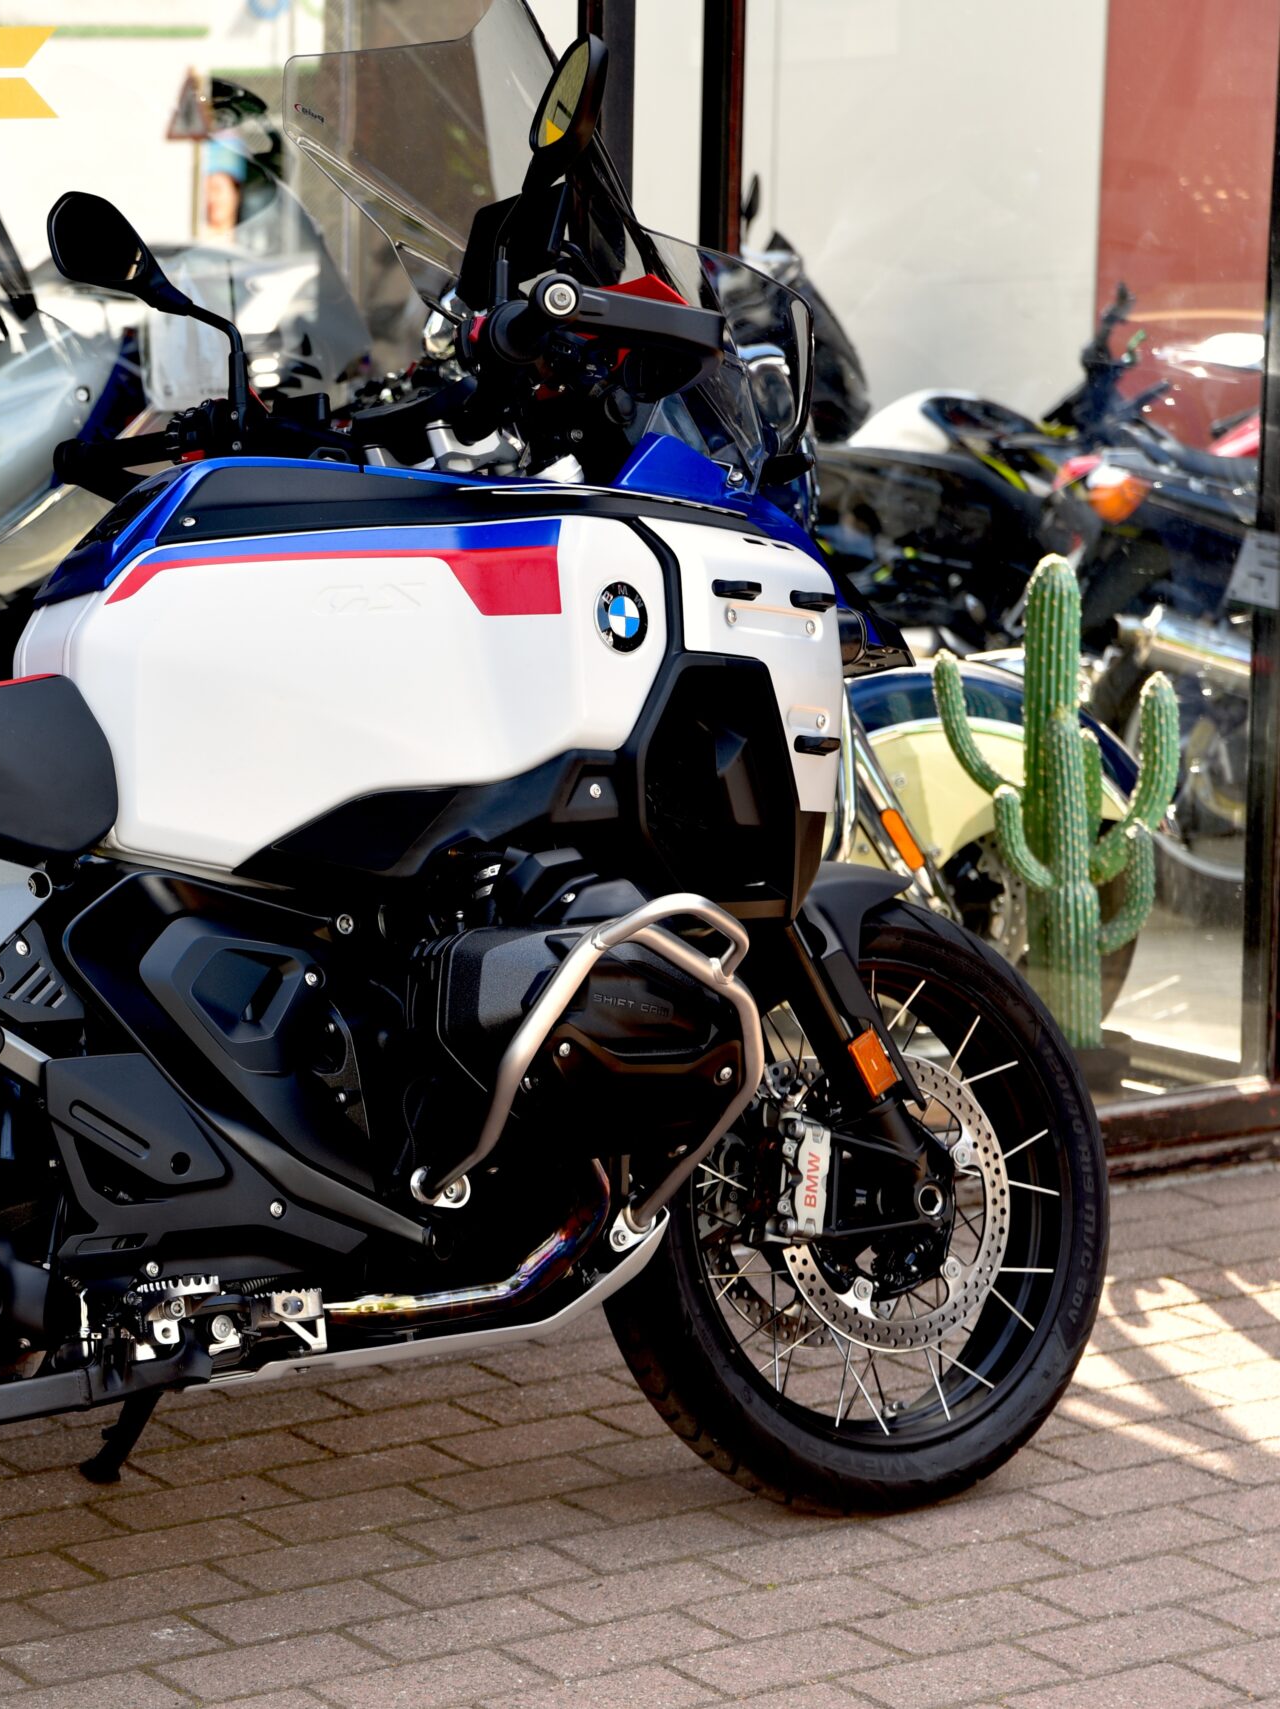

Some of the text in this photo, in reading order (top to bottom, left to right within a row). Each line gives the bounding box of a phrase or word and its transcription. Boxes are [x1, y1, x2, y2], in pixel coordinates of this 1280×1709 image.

[602, 583, 644, 609] BMW
[593, 993, 635, 1009] SHIFT
[804, 1152, 821, 1208] BMW
